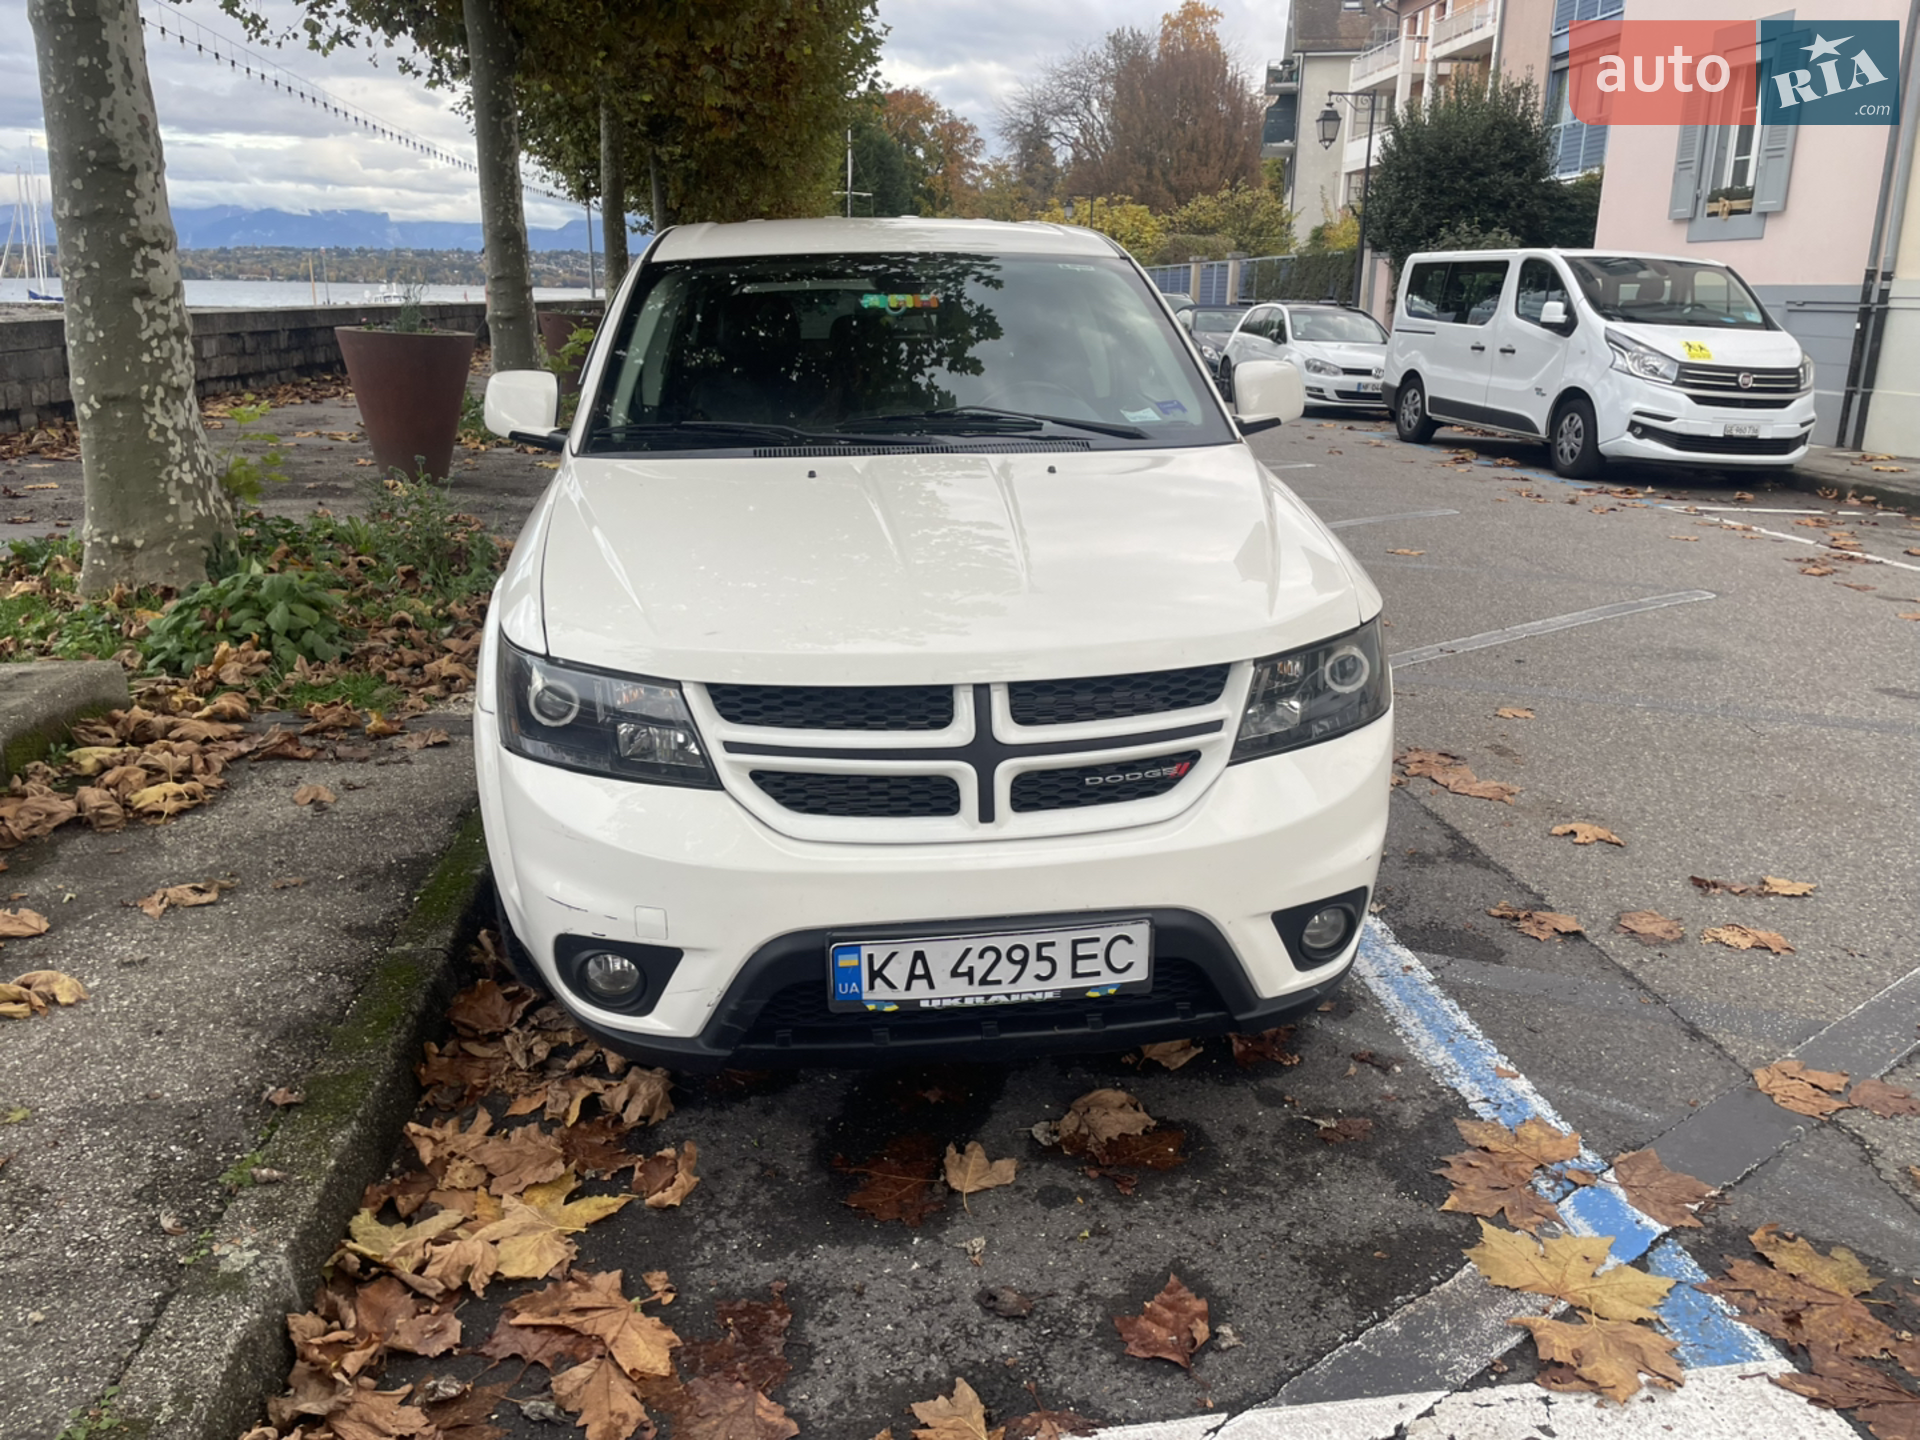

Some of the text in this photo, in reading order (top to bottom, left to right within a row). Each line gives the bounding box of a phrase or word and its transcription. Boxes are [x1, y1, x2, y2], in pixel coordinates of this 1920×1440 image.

[1085, 766, 1177, 785] DODGE
[867, 934, 1135, 992] KA 4295 EC
[839, 984, 860, 994] UA
